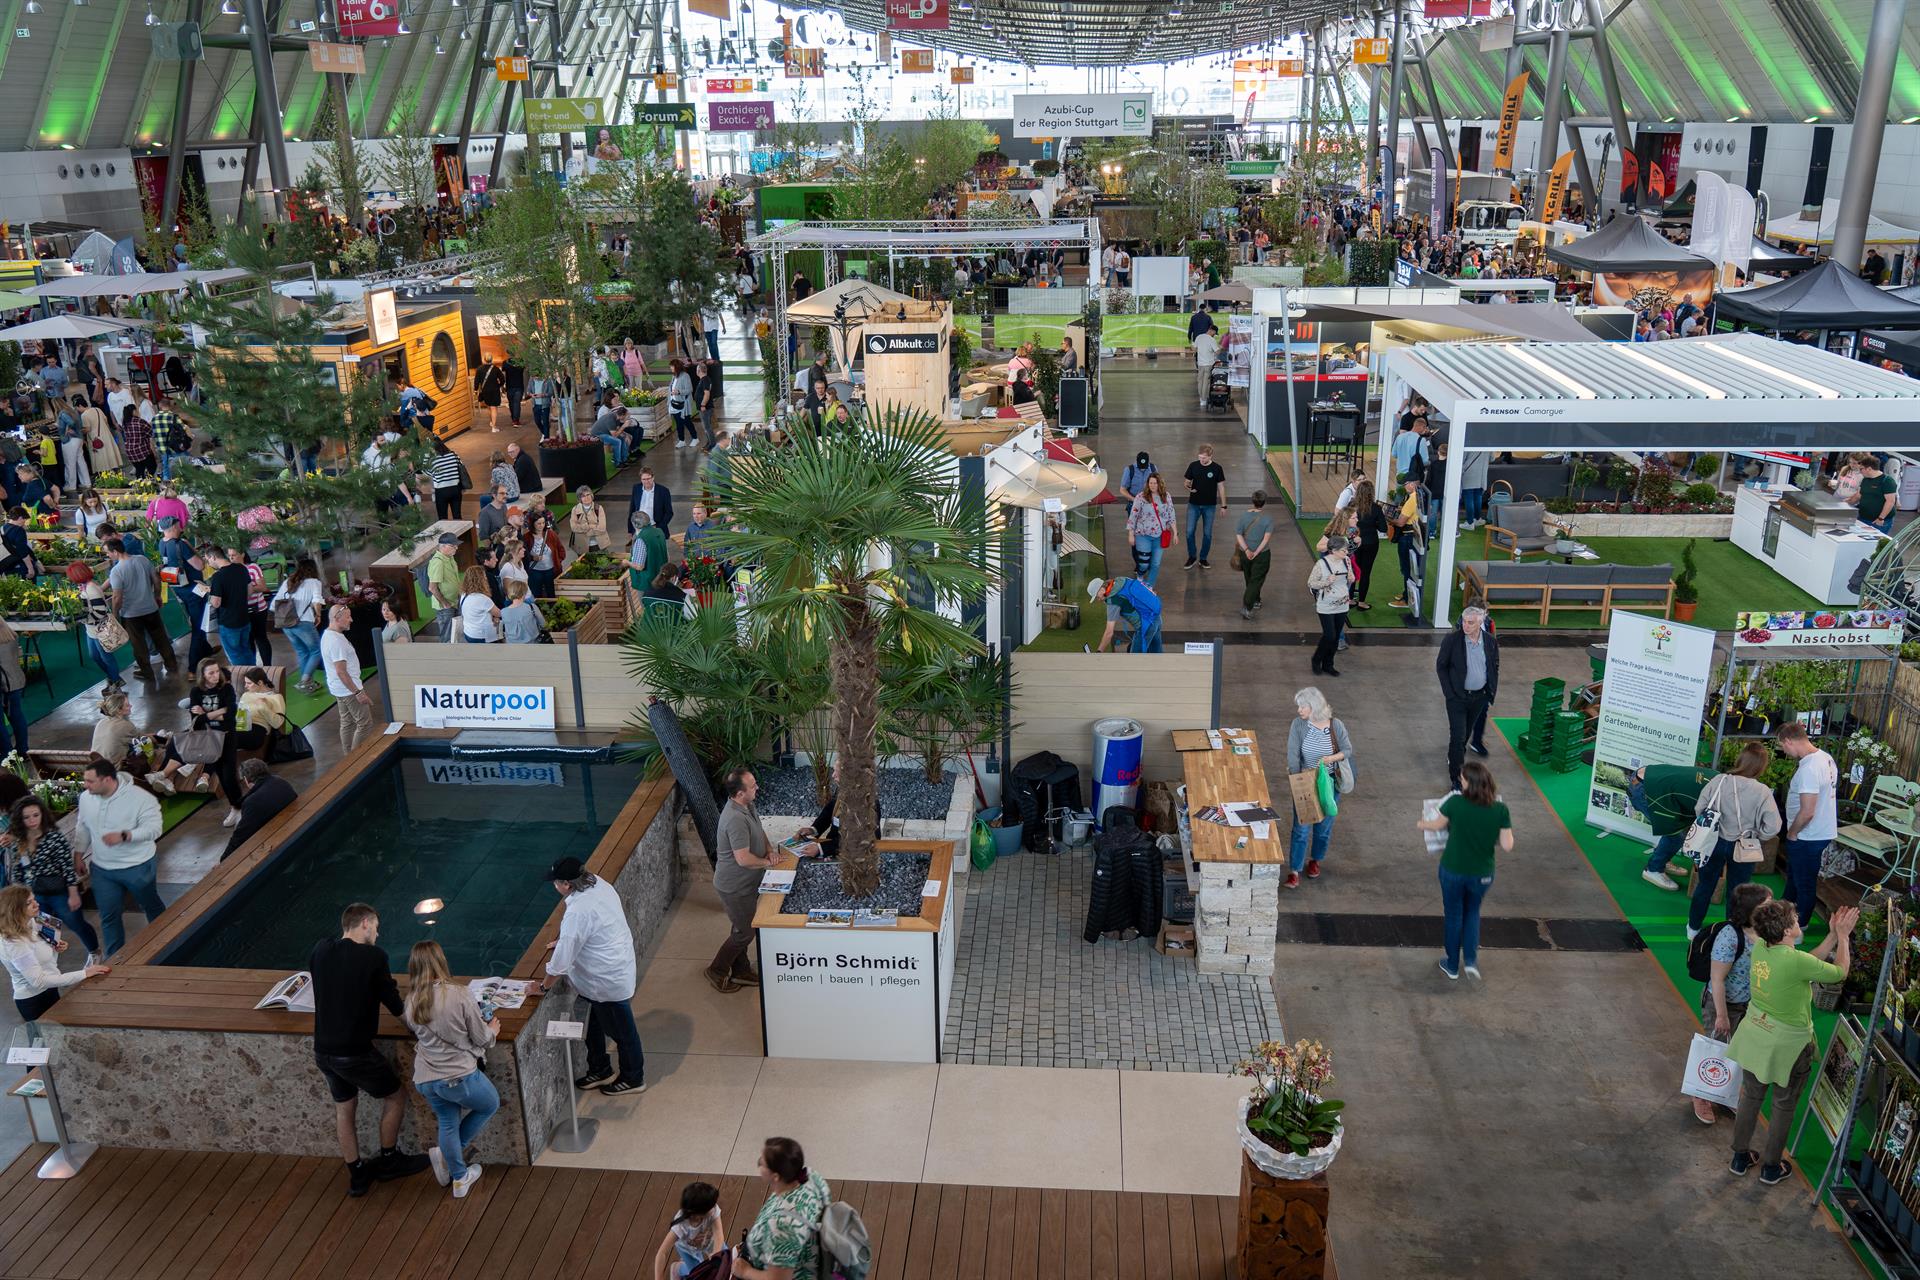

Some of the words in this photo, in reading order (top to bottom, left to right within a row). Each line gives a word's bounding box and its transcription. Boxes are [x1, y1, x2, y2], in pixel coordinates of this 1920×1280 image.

[343, 10, 363, 20] Hall
[370, 0, 386, 20] 6
[725, 80, 732, 89] 4
[717, 105, 766, 114] Orchideen
[1044, 105, 1094, 116] Azubi-Cup
[554, 111, 570, 121] und
[638, 111, 679, 123] Forum
[718, 116, 750, 125] Exotic.
[1019, 118, 1036, 128] der
[1038, 118, 1072, 129] Region
[1074, 117, 1119, 129] Stuttgart
[889, 338, 936, 349] Albkult.de
[1523, 406, 1564, 417] Camargue
[1792, 633, 1871, 644] Naschobst
[1610, 657, 1629, 666] Welche
[1630, 661, 1644, 671] Frage
[1645, 664, 1663, 674] könnte
[1674, 672, 1690, 681] Ihnen
[421, 687, 546, 714] Naturpool
[1604, 714, 1662, 738] Gartenberatung
[1664, 731, 1677, 741] vor
[1678, 735, 1691, 745] Ort
[776, 953, 828, 970] Björn
[836, 954, 918, 970] Schmidt
[777, 974, 813, 984] planen
[830, 974, 863, 984] bauen
[880, 976, 920, 987] pflegen
